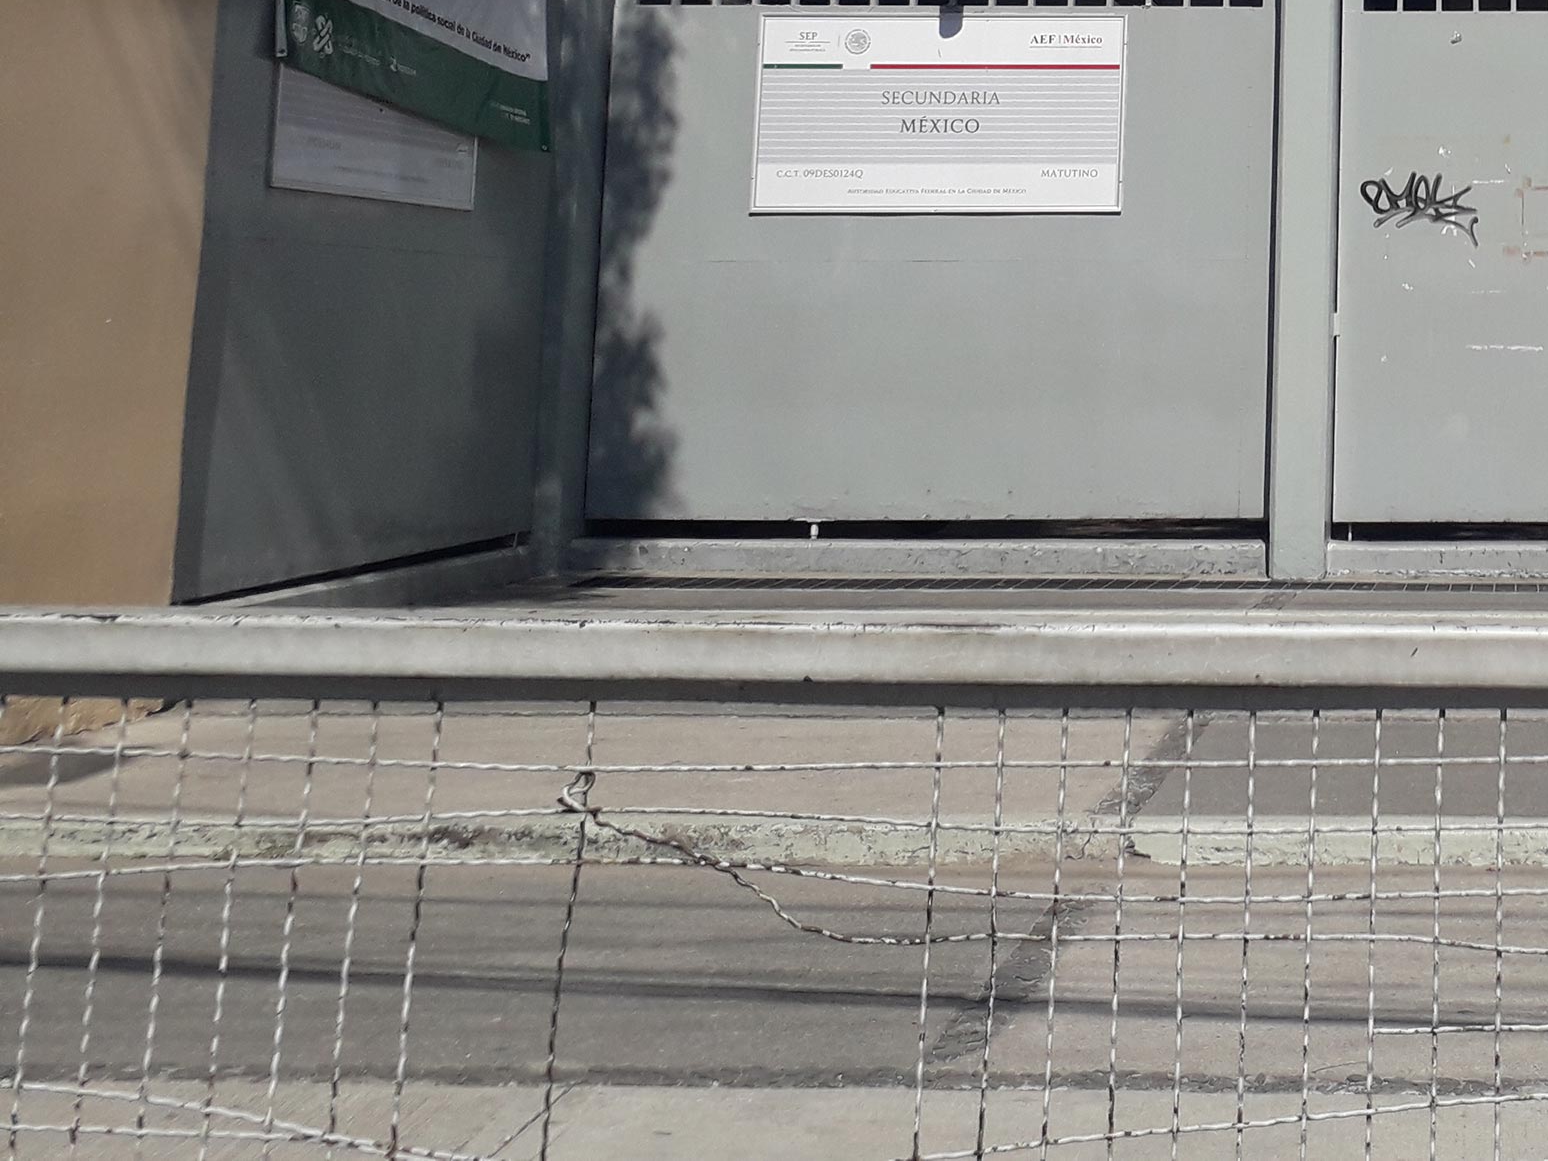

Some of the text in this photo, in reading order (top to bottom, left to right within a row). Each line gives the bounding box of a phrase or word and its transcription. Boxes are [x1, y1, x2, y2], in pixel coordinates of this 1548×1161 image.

[799, 31, 818, 41] SEP
[1030, 34, 1103, 44] AEF México
[881, 90, 1000, 105] SECUNDARIA
[899, 115, 980, 134] MÉXICO
[803, 169, 864, 179] 09DES0124Q
[1040, 169, 1098, 178] MATUTINO
